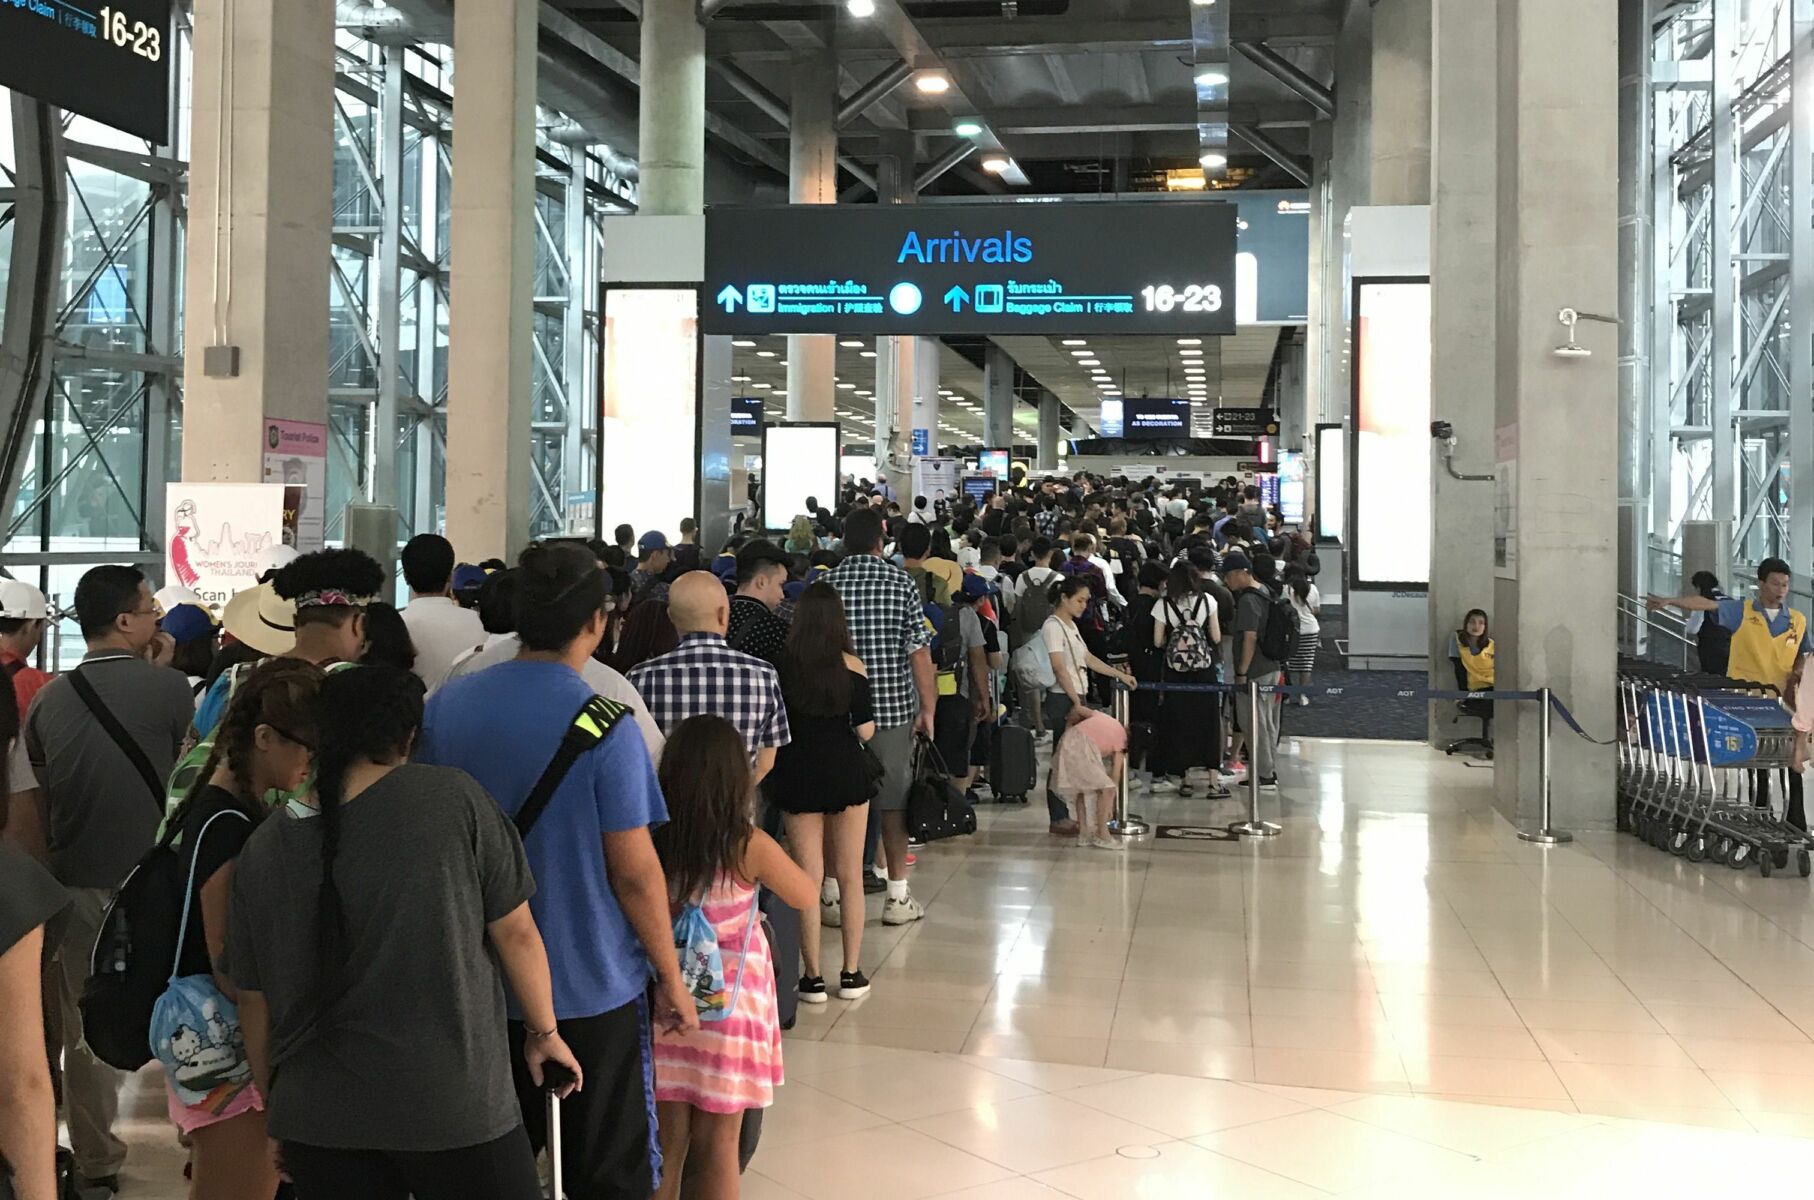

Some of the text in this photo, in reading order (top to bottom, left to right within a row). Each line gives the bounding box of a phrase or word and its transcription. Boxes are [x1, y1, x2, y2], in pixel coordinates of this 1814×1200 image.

[100, 6, 160, 61] 16-23
[897, 230, 1033, 263] Arrivals
[1141, 285, 1222, 312] 16-23
[778, 302, 835, 315] Immigration
[1006, 302, 1084, 315] Baggage Claim
[210, 569, 256, 577] THAILAND
[194, 588, 226, 602] Scan
